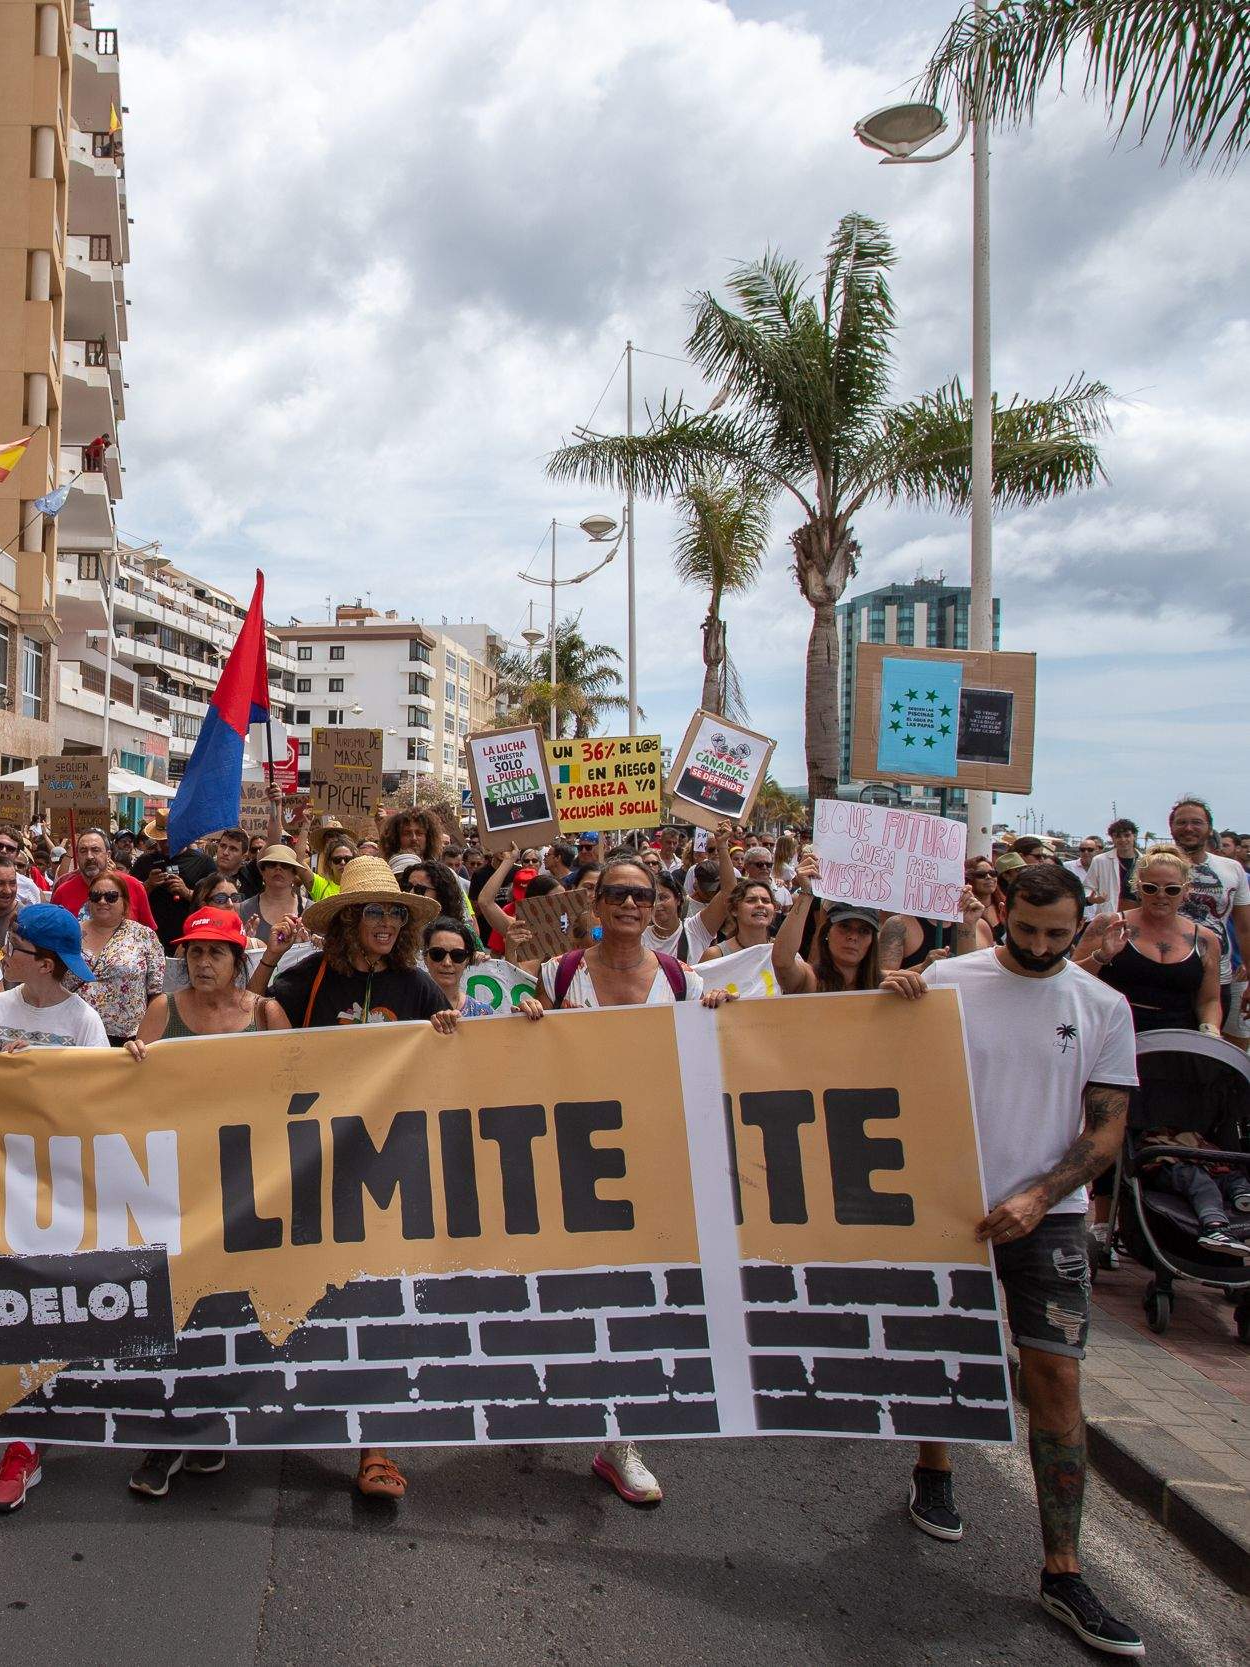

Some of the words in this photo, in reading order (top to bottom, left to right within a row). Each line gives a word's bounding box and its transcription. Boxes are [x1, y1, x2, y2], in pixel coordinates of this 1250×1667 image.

[316, 733, 330, 748] EL
[370, 732, 382, 750] DE
[483, 746, 495, 756] LA
[496, 740, 527, 755] LUCHA
[334, 751, 373, 767] MASAS
[497, 751, 524, 762] NUESTRA
[553, 746, 573, 759] UN
[581, 741, 616, 762] 36%
[620, 742, 631, 754] DE
[487, 774, 498, 783] EL
[499, 767, 533, 781] PUEBLO
[495, 759, 523, 773] SOLO
[588, 766, 606, 780] EN
[695, 752, 750, 780] CANARIAS
[700, 764, 709, 772] no
[719, 771, 739, 783] vende
[49, 781, 75, 791] AGUA
[493, 779, 534, 799] SALVA
[569, 781, 628, 800] POBREZA
[635, 779, 656, 792] Y/O
[691, 768, 703, 778] SE
[703, 772, 742, 793] DEFIENDE
[496, 798, 506, 806] AL
[507, 793, 534, 805] PUEBLO
[557, 800, 614, 820] XCLUSIÓN
[619, 800, 658, 816] SOCIAL
[882, 811, 961, 861] FUTURO
[851, 841, 895, 869] QUEDA
[906, 856, 939, 880] PARA
[815, 858, 894, 902] NUESTROS
[4, 1130, 182, 1257] UN
[219, 1092, 635, 1253] LÍMITE
